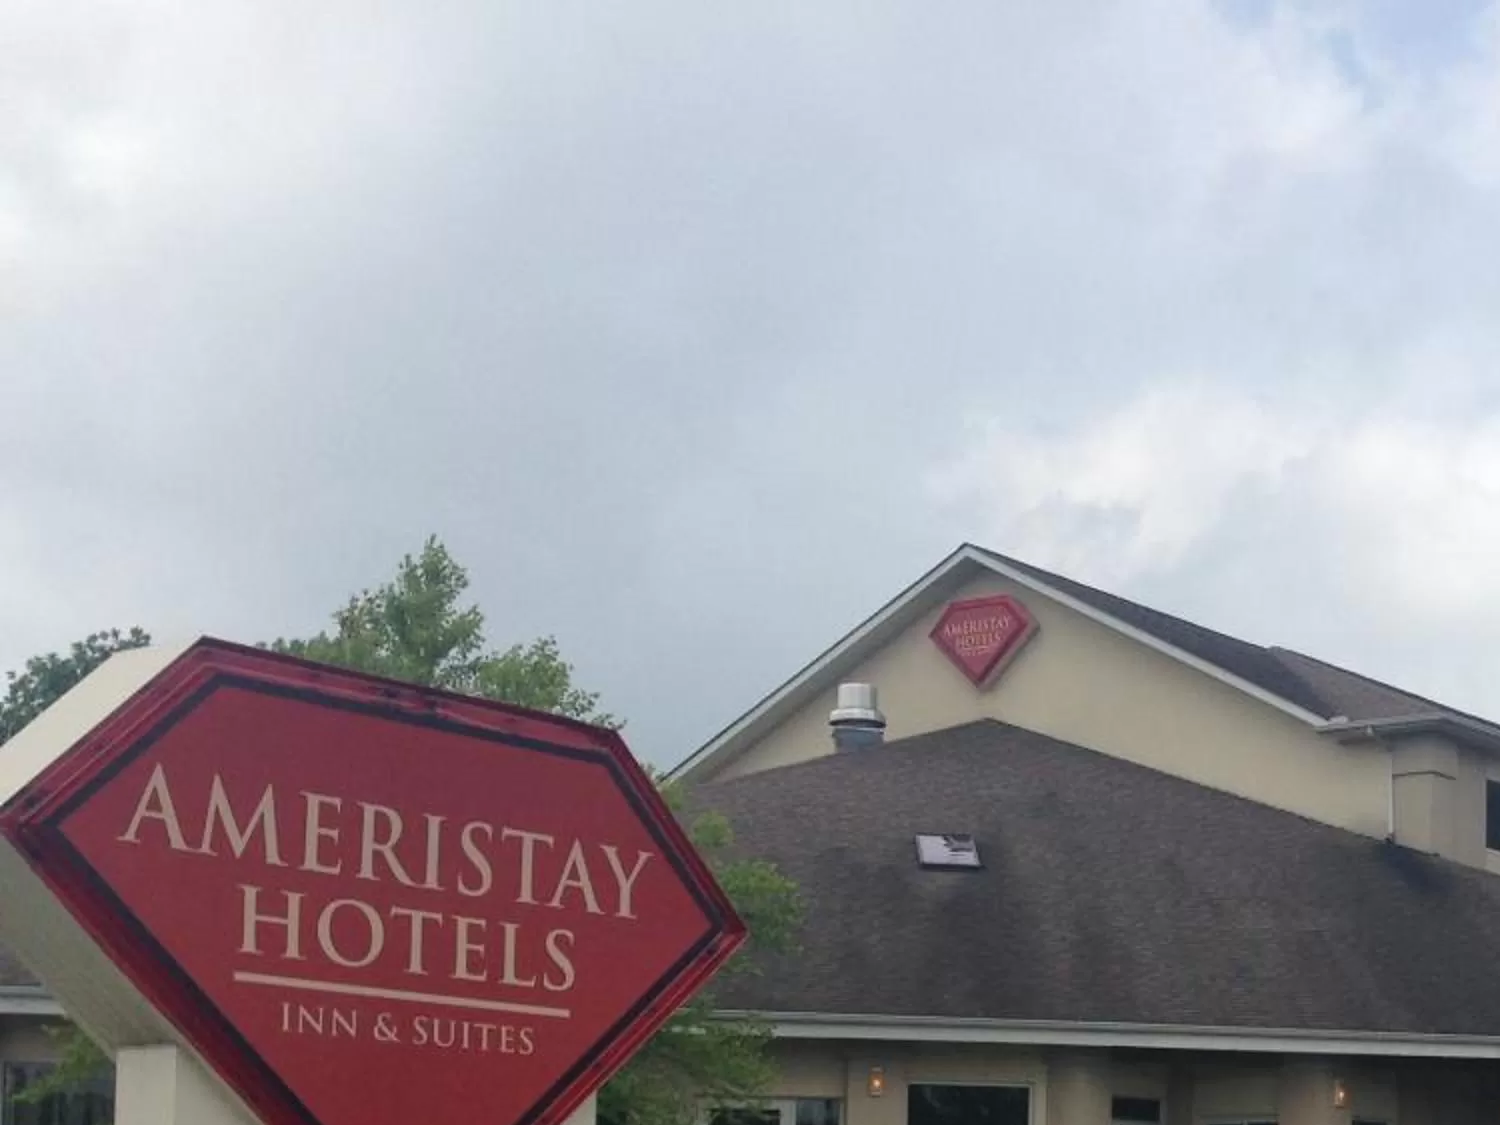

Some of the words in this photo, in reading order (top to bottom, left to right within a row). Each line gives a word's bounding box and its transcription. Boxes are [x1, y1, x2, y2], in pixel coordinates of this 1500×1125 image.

[117, 762, 655, 920] AMERISTAY
[238, 884, 575, 992] HOTELS
[281, 1002, 358, 1037] INN
[373, 1013, 400, 1042] &
[413, 1016, 534, 1055] SUITES
